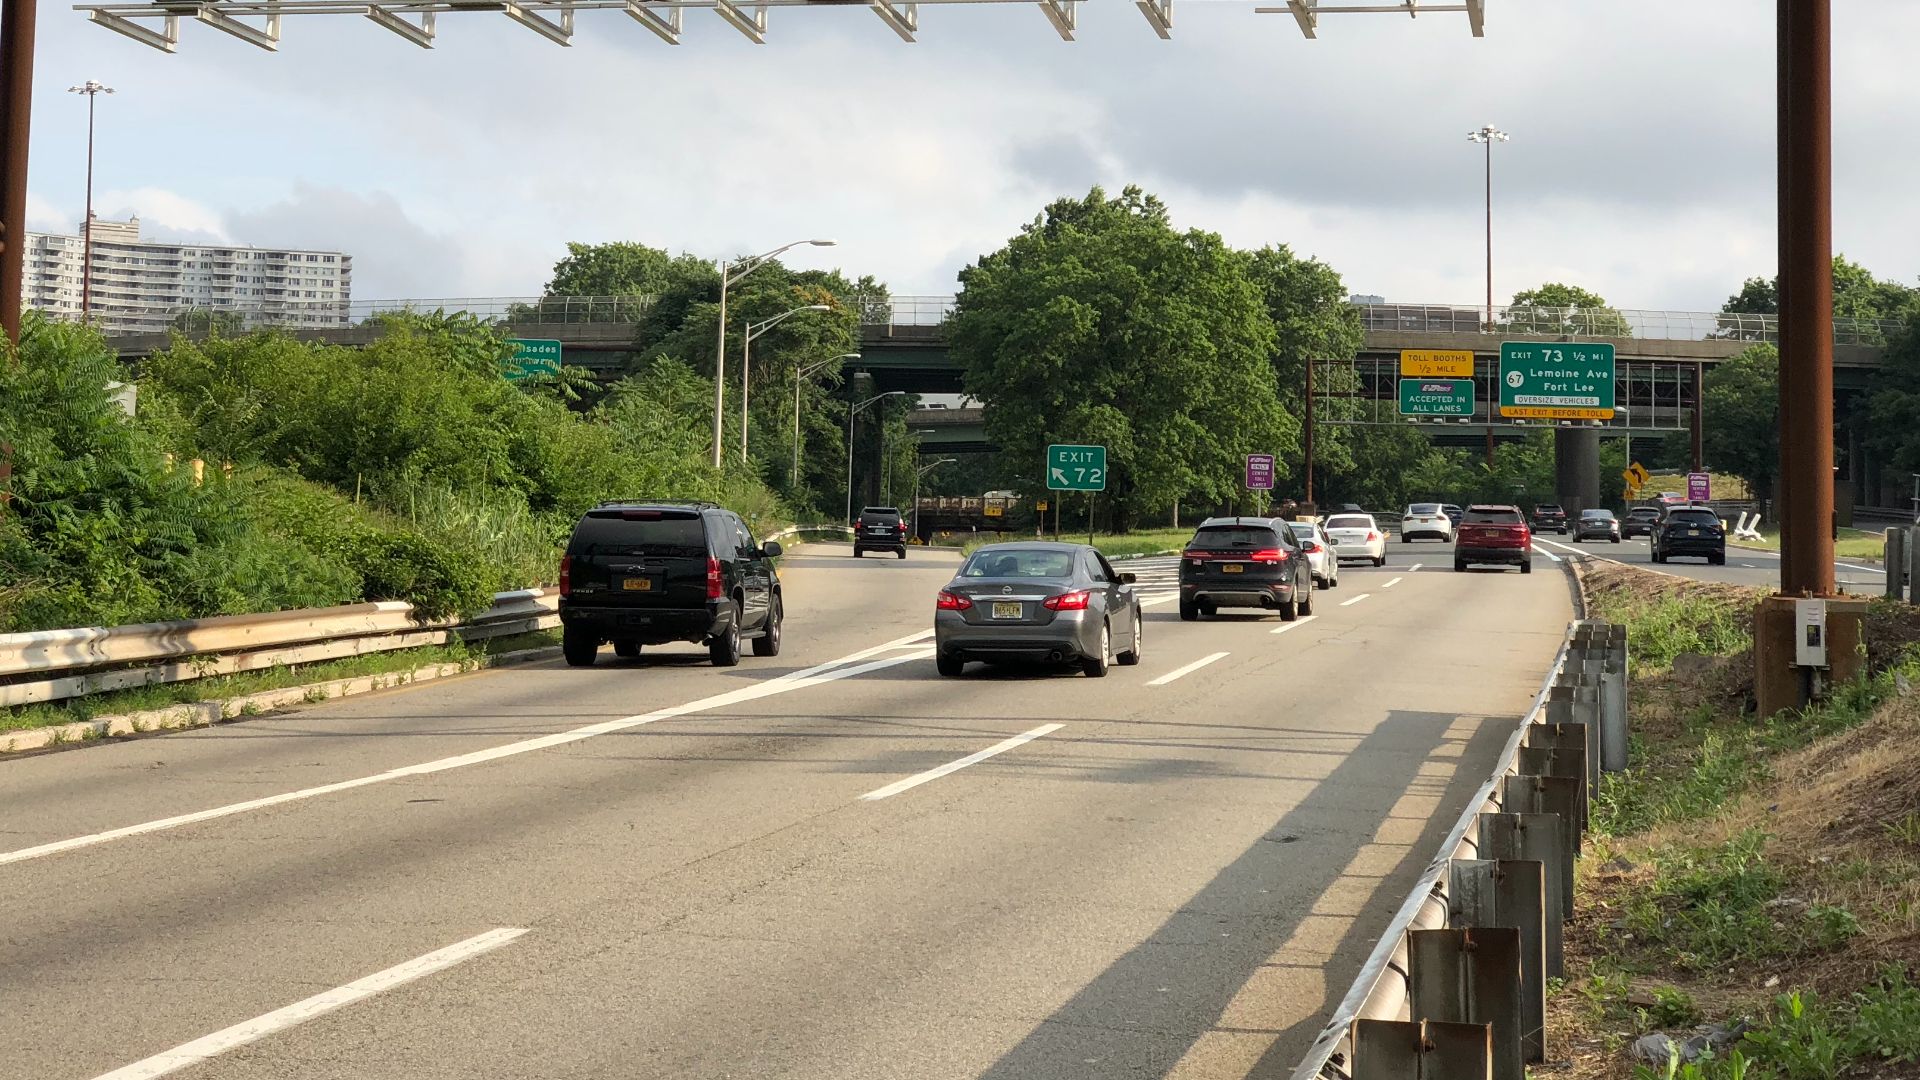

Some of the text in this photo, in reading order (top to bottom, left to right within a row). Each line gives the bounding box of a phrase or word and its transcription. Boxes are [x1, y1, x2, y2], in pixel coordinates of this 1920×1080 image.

[1408, 354, 1429, 362] TOLL
[1511, 351, 1532, 359] EXIT
[1541, 349, 1564, 363] 73
[1592, 353, 1604, 361] MI
[1530, 368, 1608, 379] Lemoine Ave
[1508, 374, 1521, 384] 67
[1544, 382, 1595, 392] Fort Lee
[1408, 395, 1453, 403] ACCEPTED
[1518, 396, 1595, 405] OVERSIZE VEHICLES
[1412, 404, 1462, 412] ALL LANES
[1509, 408, 1604, 418] LAST EXIT BEFORE TOLL
[1059, 451, 1094, 463] EXIT
[1074, 467, 1102, 483] 72
